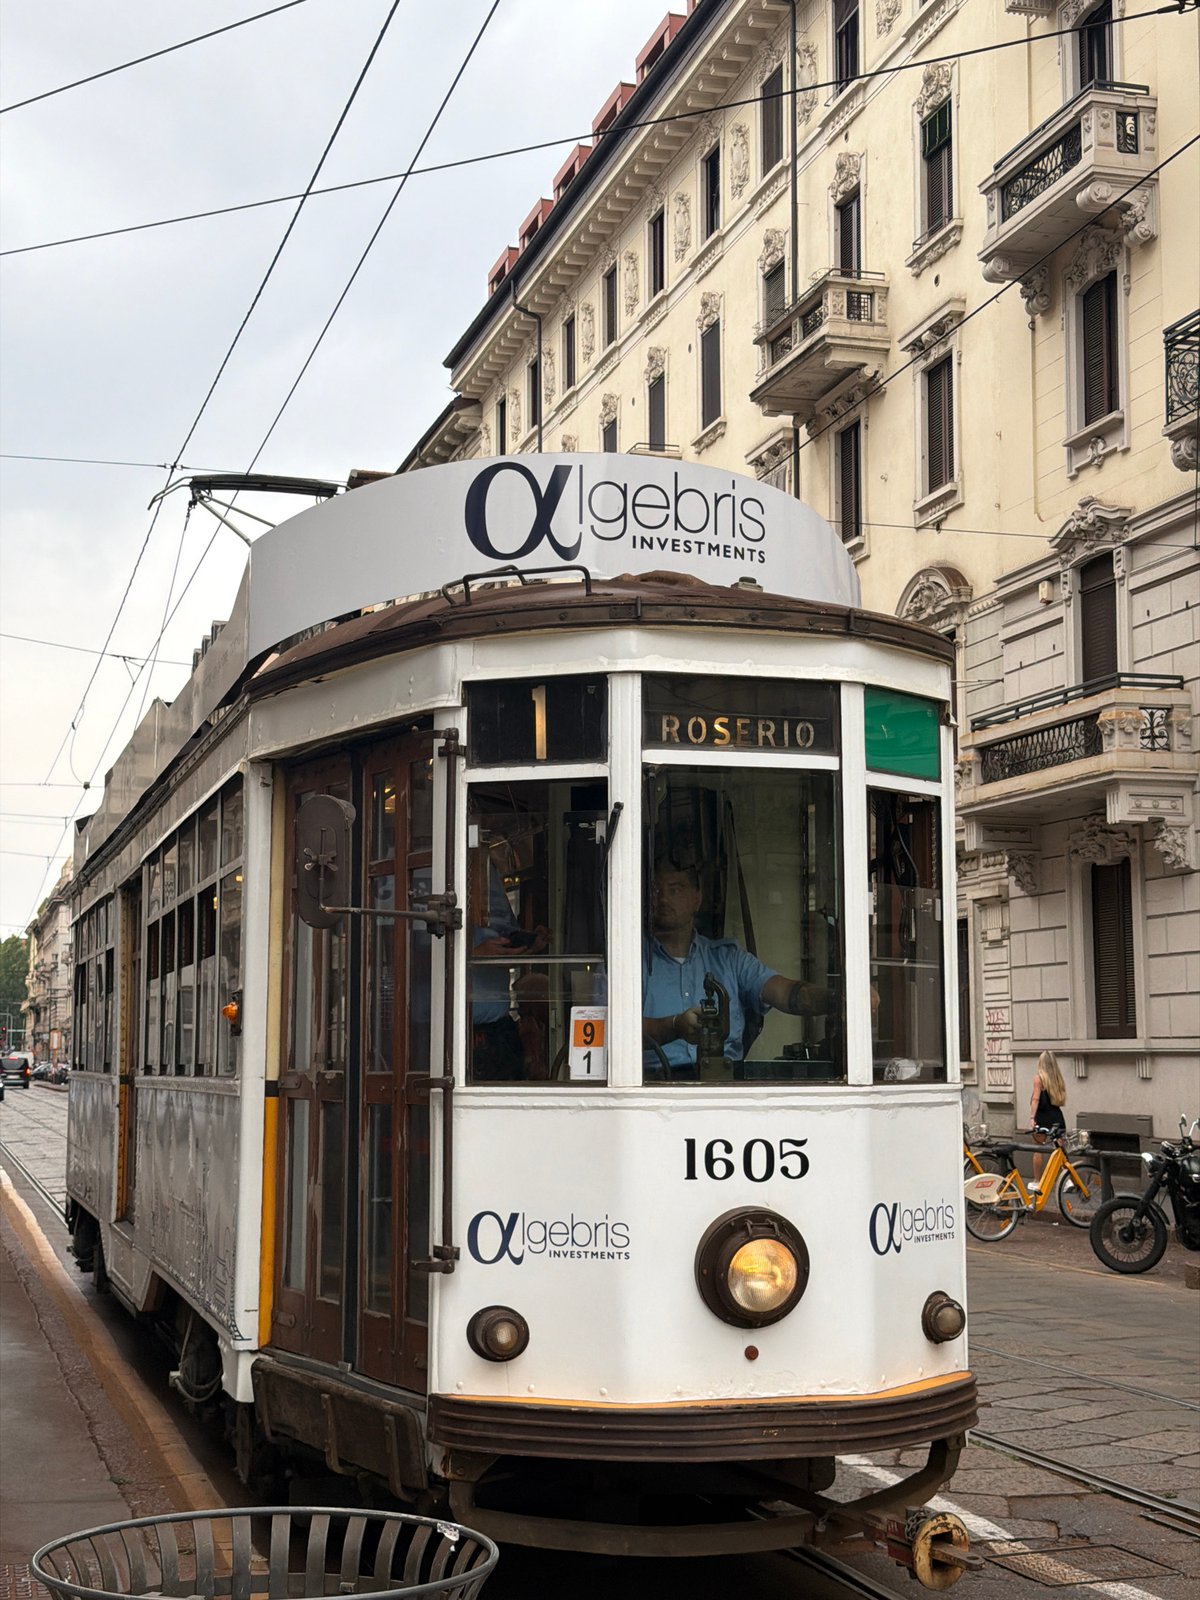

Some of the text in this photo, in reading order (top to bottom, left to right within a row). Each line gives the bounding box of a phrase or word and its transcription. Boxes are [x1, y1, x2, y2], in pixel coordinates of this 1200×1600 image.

[632, 535, 766, 564] INVESTMENTS
[532, 685, 546, 760] 1
[661, 714, 815, 748] ROSERIO
[582, 1021, 595, 1046] 9
[582, 1050, 592, 1074] 1
[684, 1138, 809, 1183] 1605
[914, 1232, 955, 1244] INVESTMENTS
[549, 1250, 631, 1260] INVESTMENTS
